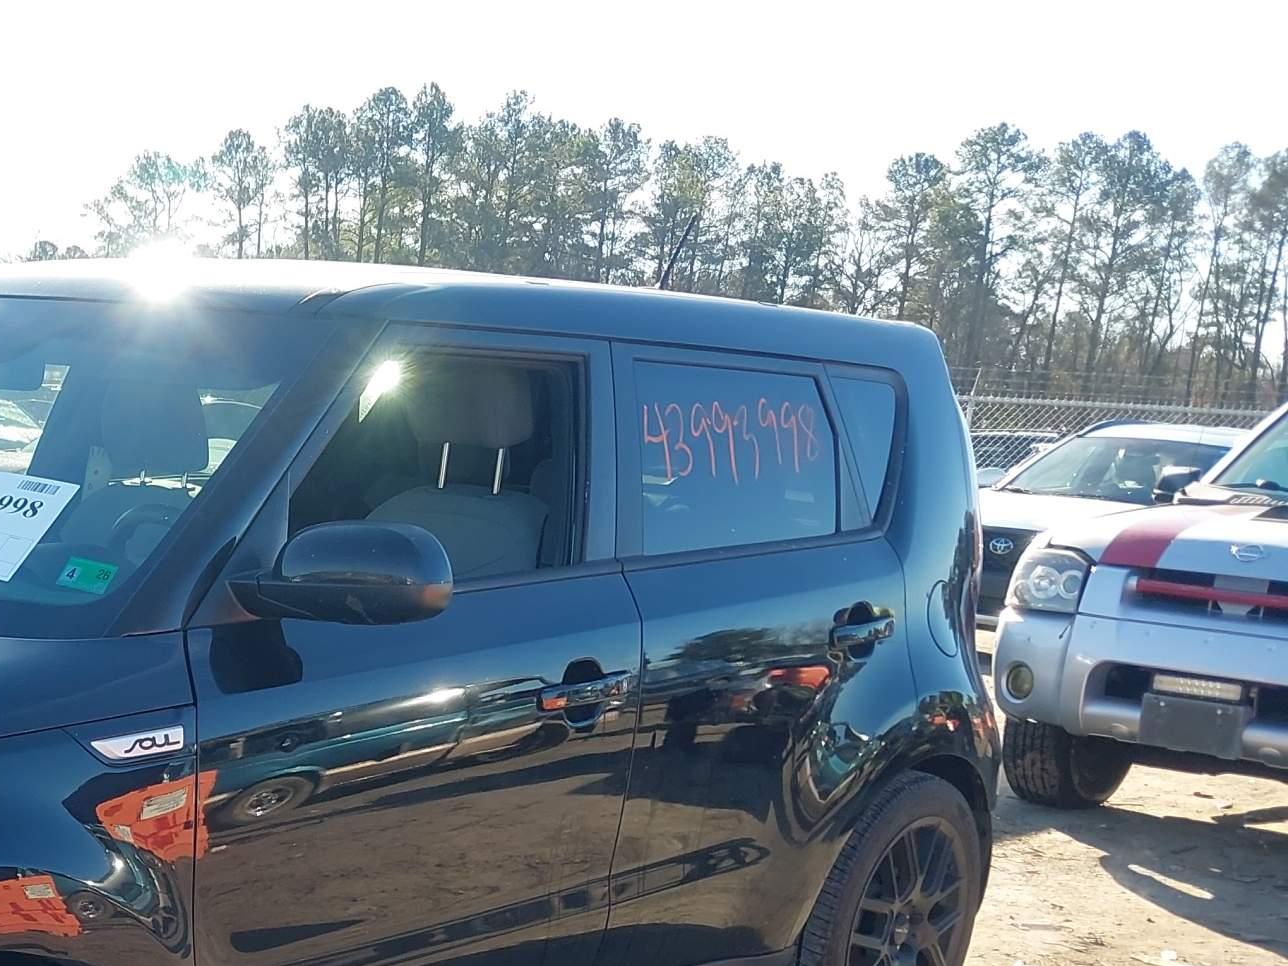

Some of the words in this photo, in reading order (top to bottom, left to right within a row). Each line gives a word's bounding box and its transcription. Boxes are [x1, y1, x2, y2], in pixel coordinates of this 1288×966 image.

[642, 398, 820, 485] 43993998
[65, 567, 77, 580] 4
[95, 568, 112, 581] 26
[124, 733, 181, 754] SOUL
